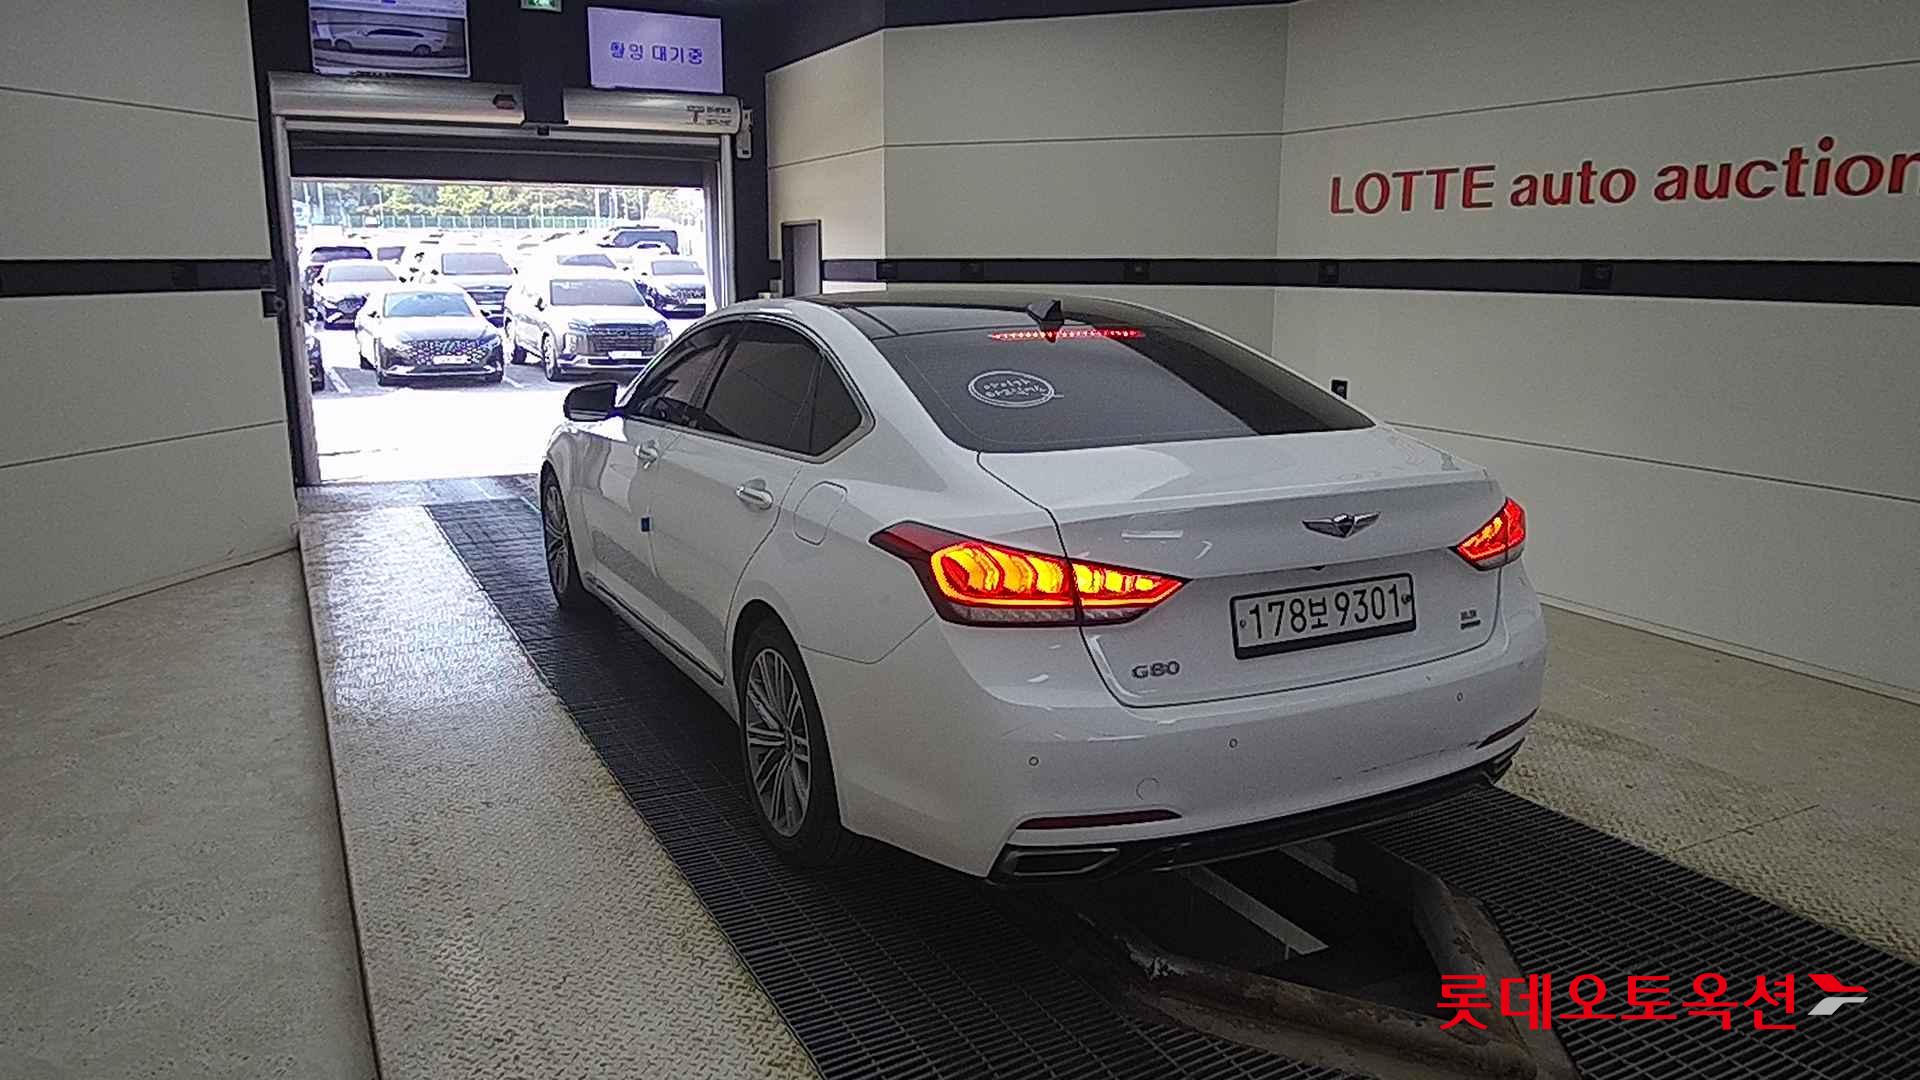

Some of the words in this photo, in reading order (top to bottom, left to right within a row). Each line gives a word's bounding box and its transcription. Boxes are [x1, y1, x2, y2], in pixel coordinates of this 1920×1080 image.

[1330, 165, 1495, 214] LOTTE
[1510, 160, 1637, 206] auto
[1249, 584, 1400, 639] 178보9301
[1132, 661, 1180, 678] G80
